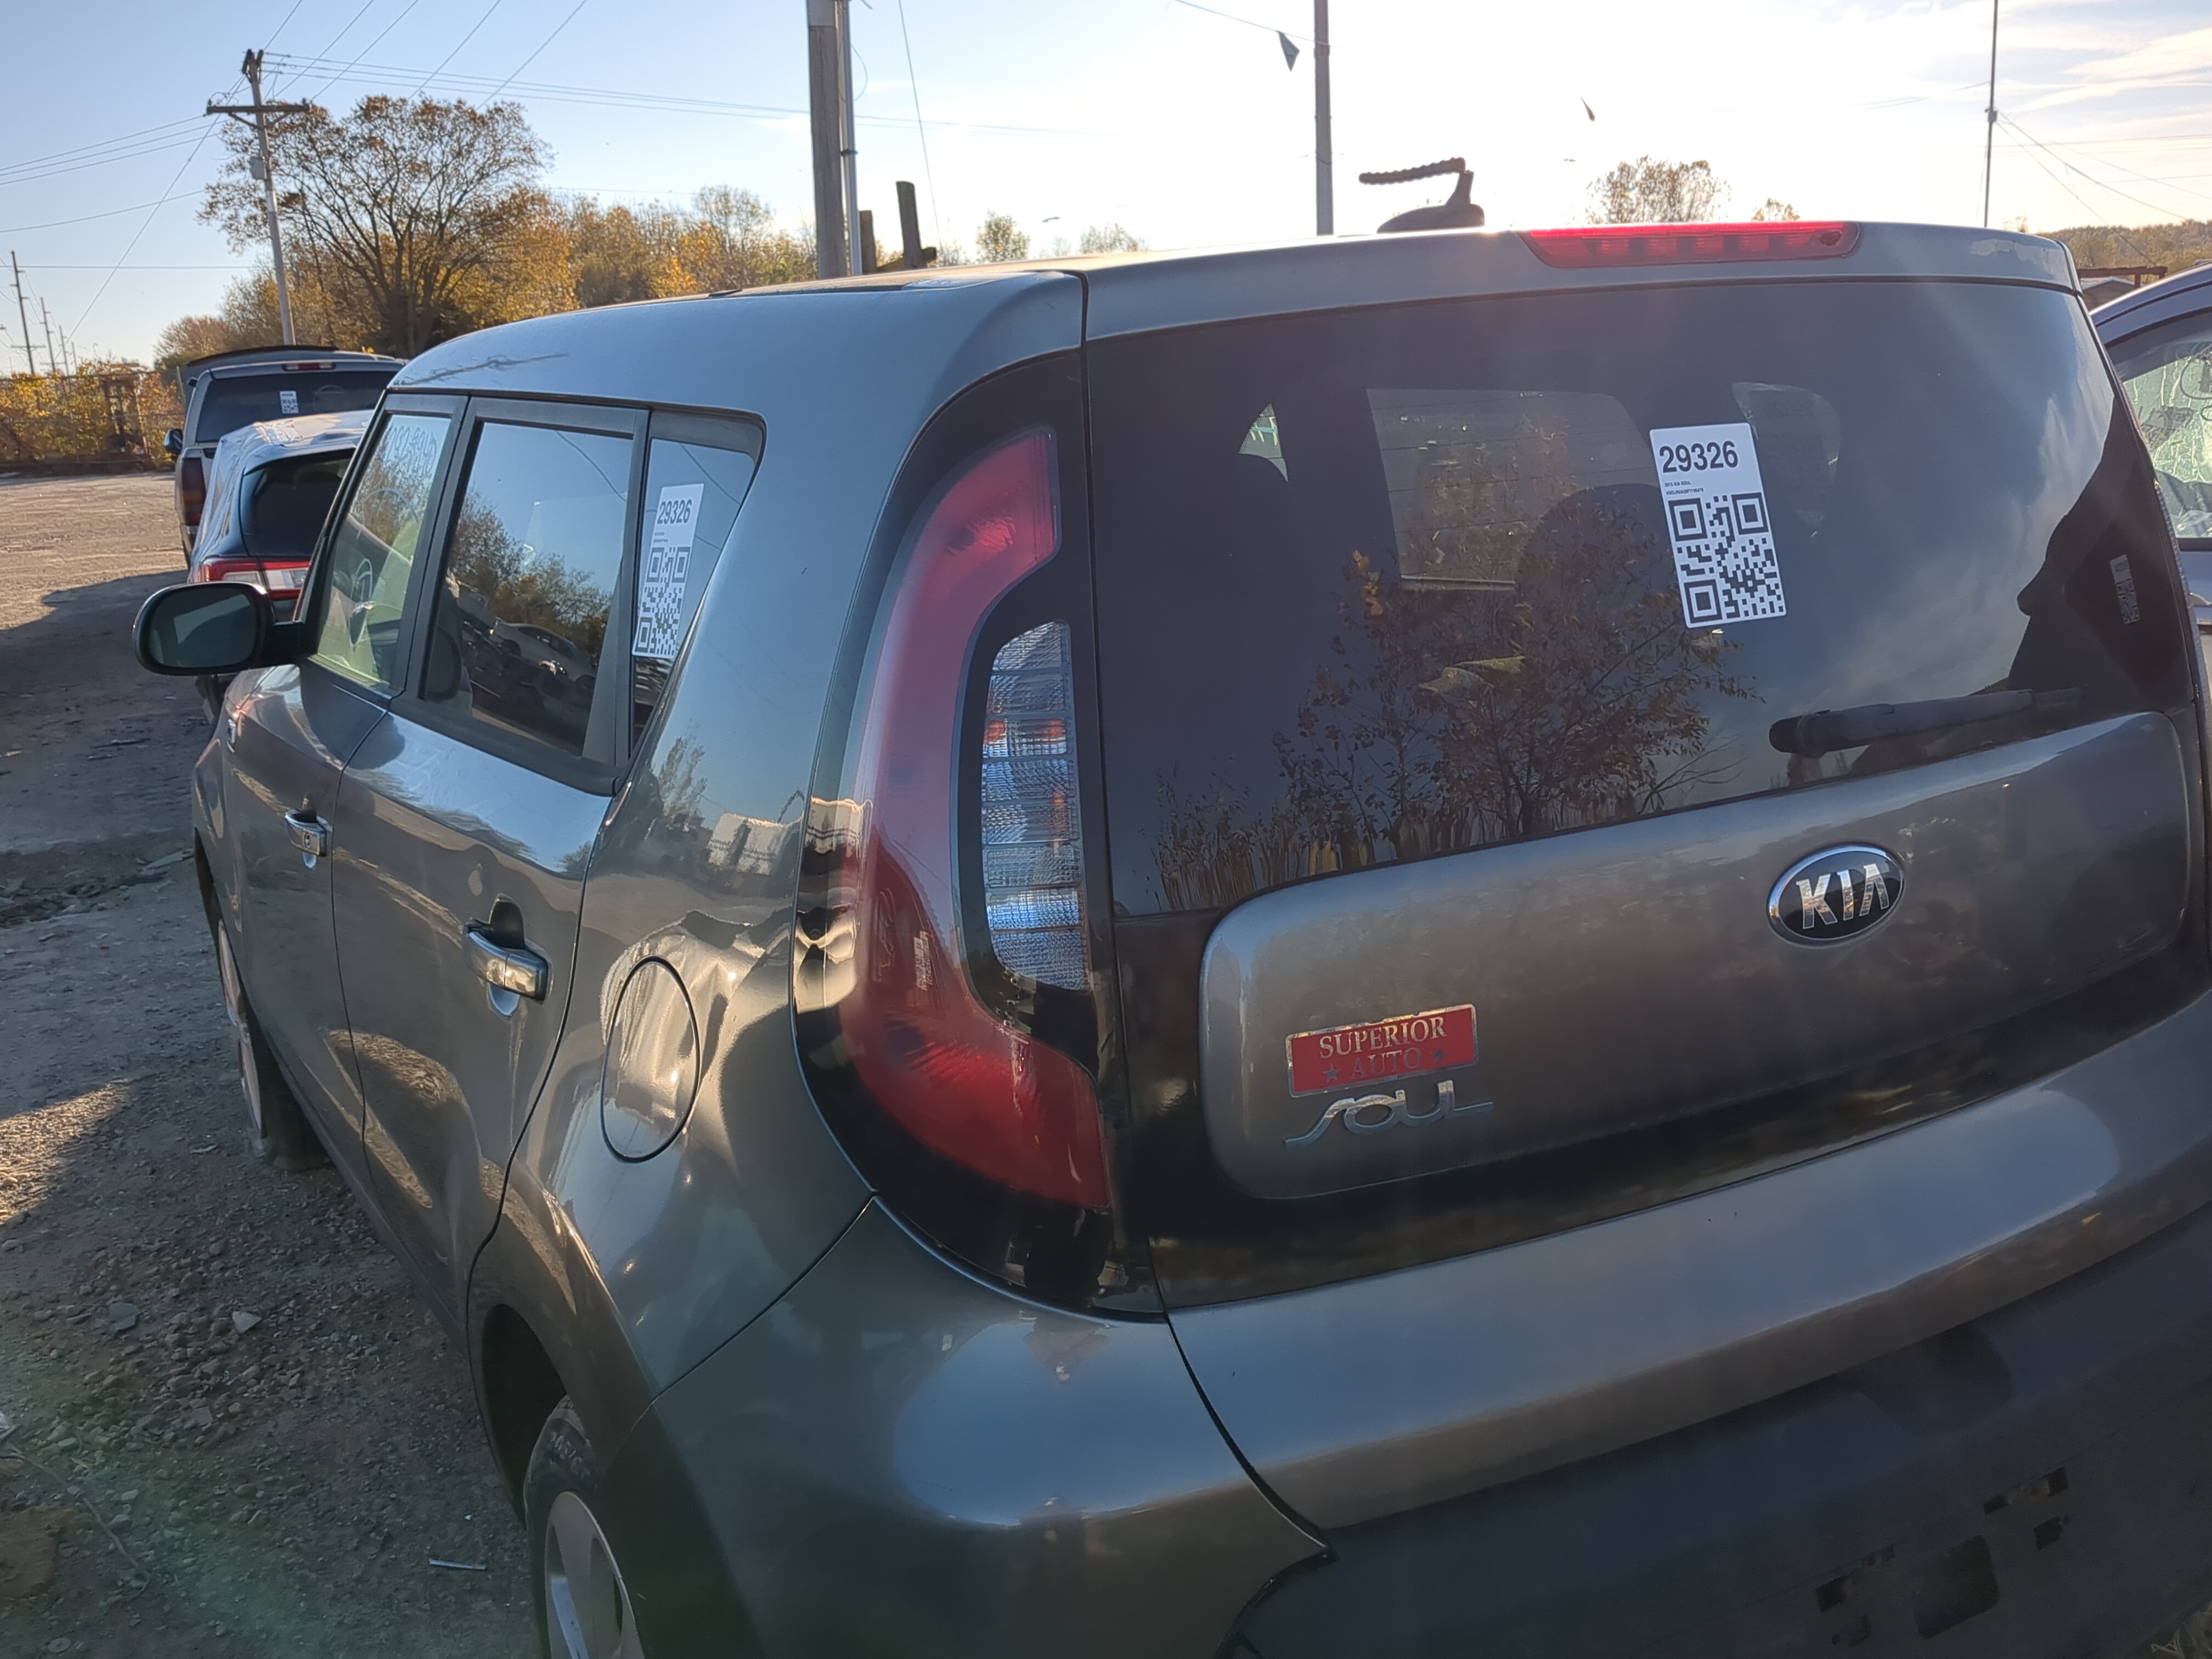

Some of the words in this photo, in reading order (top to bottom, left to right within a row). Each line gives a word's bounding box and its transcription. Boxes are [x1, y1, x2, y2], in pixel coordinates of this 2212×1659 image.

[1660, 441, 1738, 473] 29326
[657, 499, 692, 524] 29326
[1796, 863, 1890, 930] KIA
[1319, 1016, 1448, 1059] SUPERIOR
[1351, 1047, 1422, 1080] AUTO
